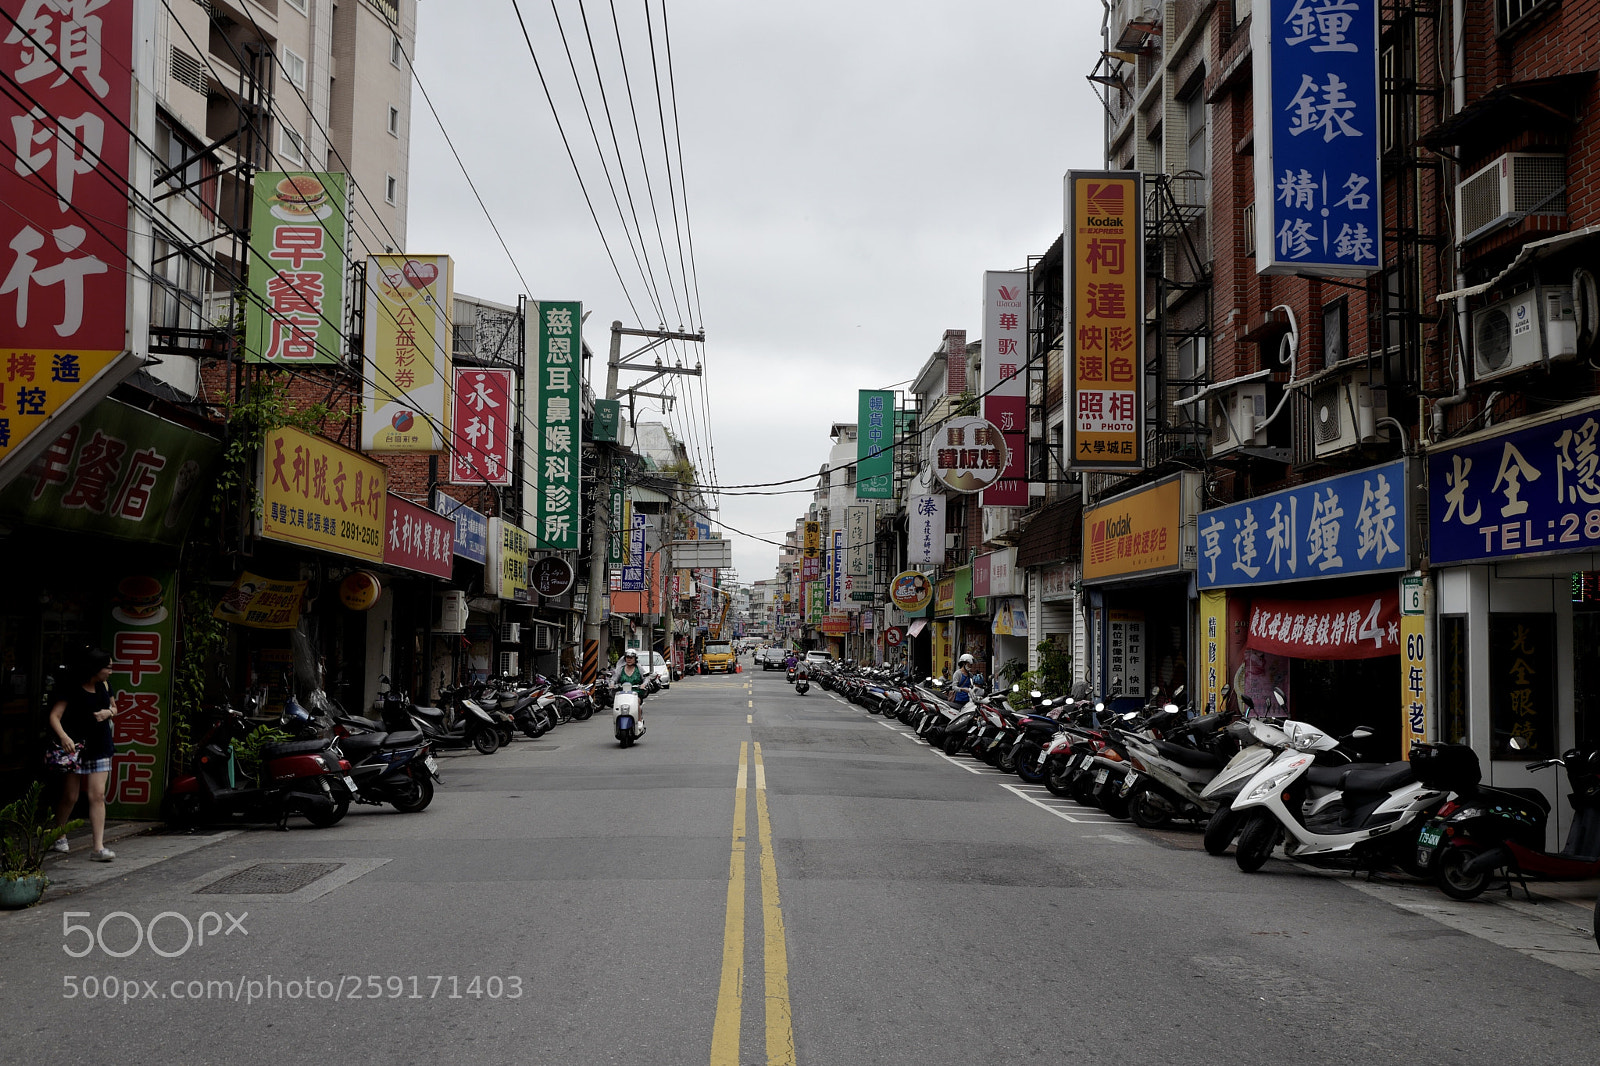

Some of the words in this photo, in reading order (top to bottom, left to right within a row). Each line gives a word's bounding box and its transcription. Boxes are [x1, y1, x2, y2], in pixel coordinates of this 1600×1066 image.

[1087, 216, 1124, 227] Kodak
[1276, 168, 1319, 260] 精修
[1333, 172, 1377, 263] 名錶
[265, 225, 326, 360] 早餐店
[1086, 238, 1127, 319] 柯達
[394, 306, 417, 389] 公益彩券
[998, 313, 1019, 381] 華歌爾
[1079, 325, 1104, 382] 快速
[1109, 326, 1134, 382] 彩色
[464, 373, 501, 451] 永利
[544, 307, 573, 543] 慈恩耳鼻喉科診所
[868, 396, 884, 459] 暢貨中心
[1079, 392, 1134, 421] 照相
[1082, 423, 1092, 431] ID
[1101, 423, 1134, 431] PHOTO
[457, 452, 503, 478] 珠寶
[937, 448, 1001, 469] 鐵板燒
[1080, 440, 1133, 455] 大學城店
[340, 520, 380, 547] 2891-2505
[1106, 513, 1132, 540] Kodak
[1200, 473, 1401, 584] 亨達利鐘錶
[1412, 591, 1419, 608] 6
[105, 631, 163, 805] 早餐店
[1407, 633, 1425, 746] 60年老
